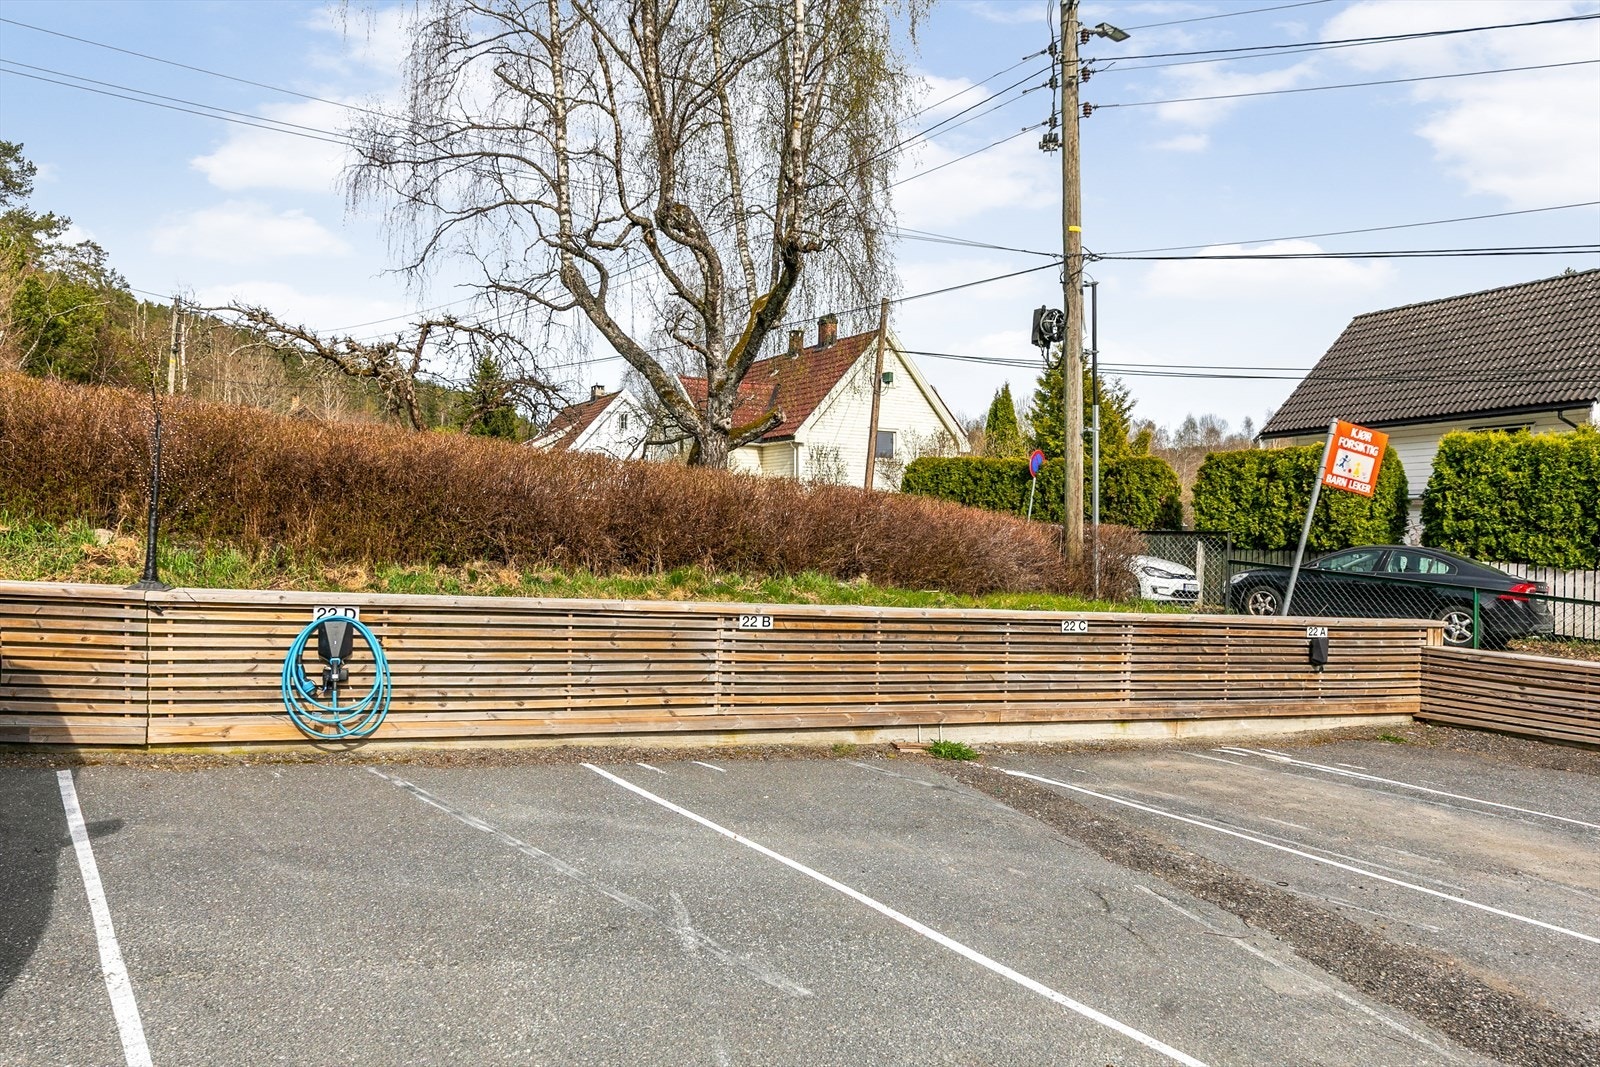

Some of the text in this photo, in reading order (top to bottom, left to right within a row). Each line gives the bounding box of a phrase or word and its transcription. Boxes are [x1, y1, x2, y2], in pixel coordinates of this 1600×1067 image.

[1350, 427, 1373, 443] KJØR
[1338, 436, 1380, 457] FORSIKTIG
[1325, 473, 1372, 494] BARN LEKER
[741, 615, 771, 628] 22 B
[1063, 620, 1087, 631] 22 C
[1308, 626, 1326, 636] 22 A
